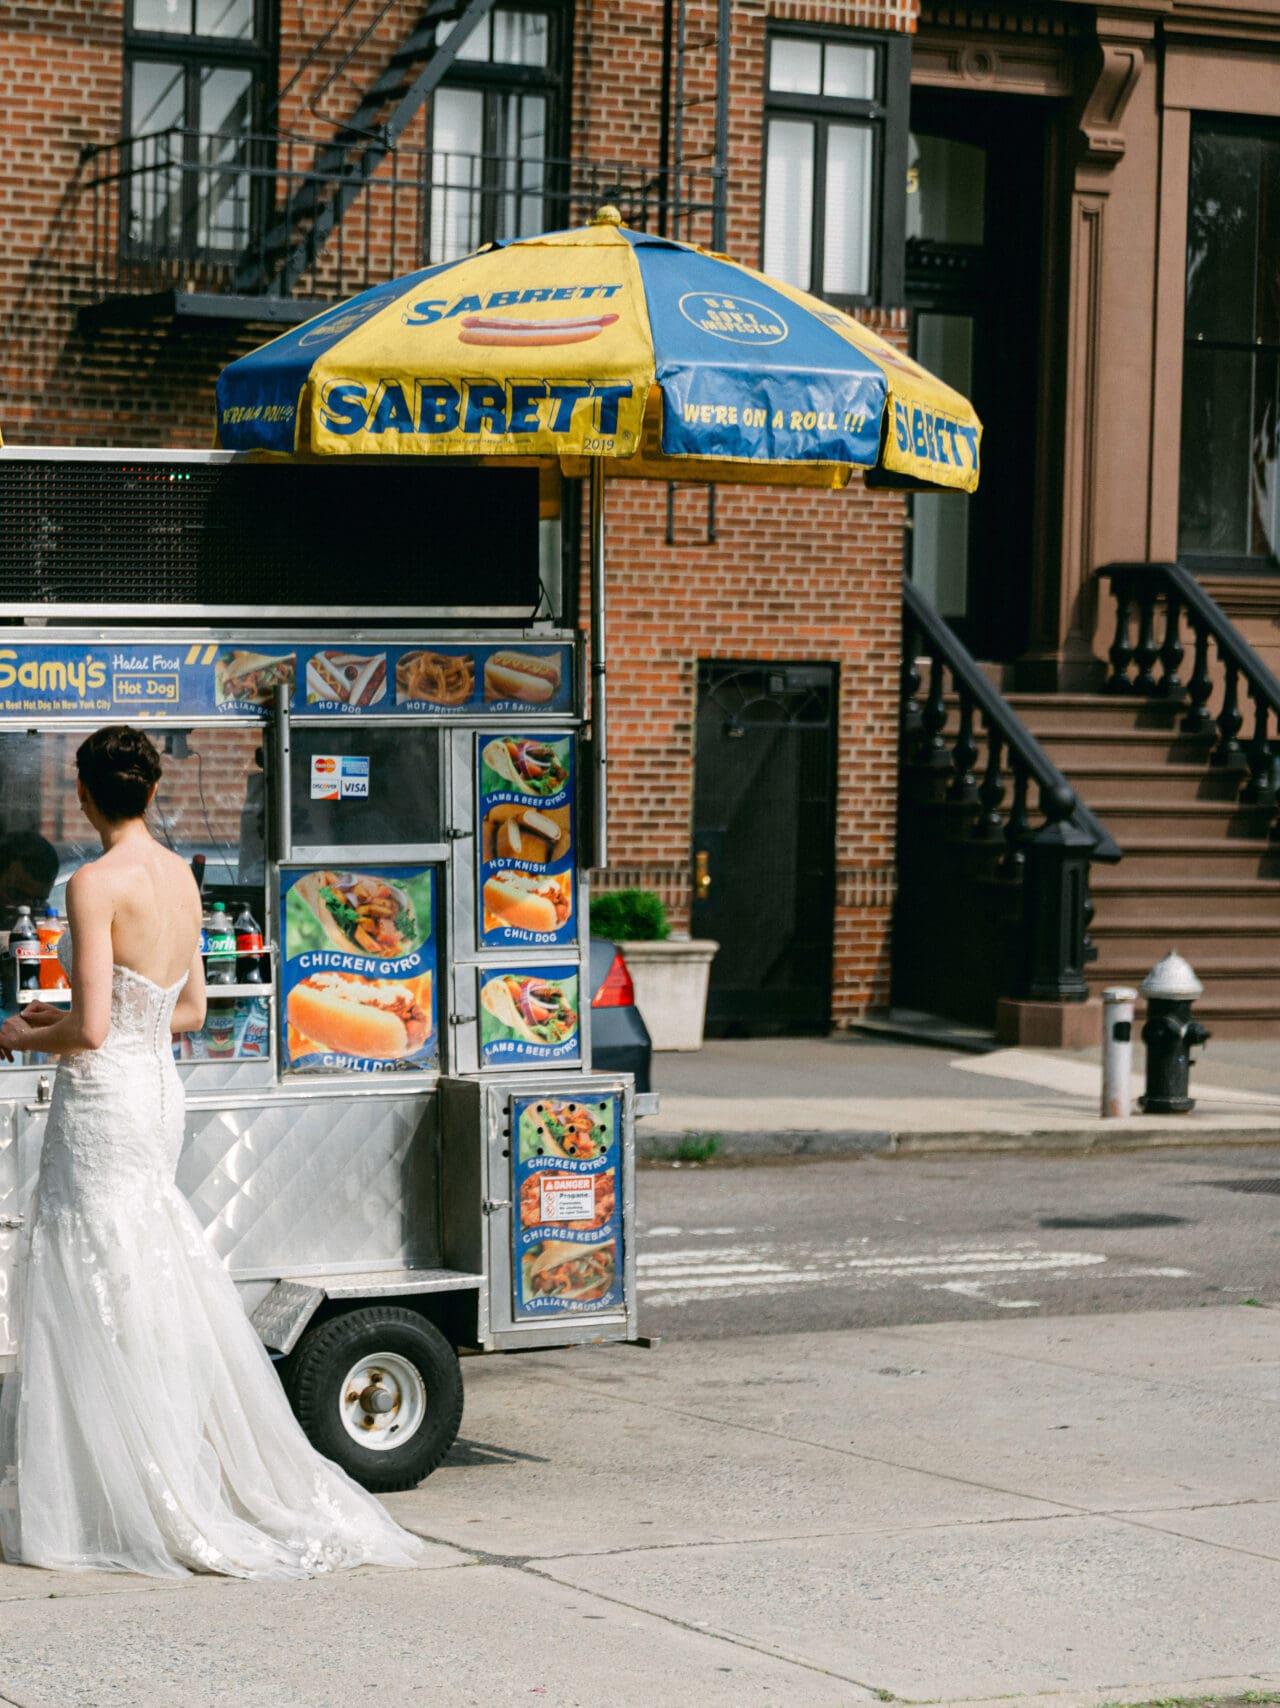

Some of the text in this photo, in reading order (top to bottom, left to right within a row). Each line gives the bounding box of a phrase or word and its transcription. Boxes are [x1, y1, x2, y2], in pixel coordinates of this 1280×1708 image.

[402, 283, 624, 326] SABRETT
[700, 318, 782, 336] INSPECTED
[320, 377, 634, 436] SABRETT
[683, 403, 738, 426] WE'RE
[742, 406, 768, 428] ON
[771, 408, 785, 430] A
[789, 410, 838, 432] ROLL
[583, 437, 615, 451] 2019
[112, 654, 180, 671] Halal Food
[118, 680, 176, 698] Hot Dog
[5, 700, 21, 711] Best
[23, 700, 37, 711] Hot
[38, 700, 51, 712] Dog
[62, 700, 78, 710] New
[79, 700, 95, 710] York
[96, 700, 111, 712] City
[218, 702, 255, 713] ITALIAN
[319, 702, 362, 714] HOT DOG
[406, 702, 426, 711] HOT
[489, 702, 508, 712] HOT
[344, 783, 367, 793] VISA
[486, 792, 567, 806] LAMB & BEEF GYRO
[489, 859, 546, 873] HOT KNISH
[504, 927, 557, 943] CHILI DOG
[299, 953, 421, 974] CHICKEN GYRO
[485, 1038, 578, 1057] LAMB & BEEF GYRO
[528, 1155, 608, 1171] CHICKEN GYRO
[554, 1179, 590, 1190] DANGER
[523, 1224, 613, 1243] CHICKEN KEBAB
[525, 1292, 615, 1311] ITALIAN SAUSAGE
